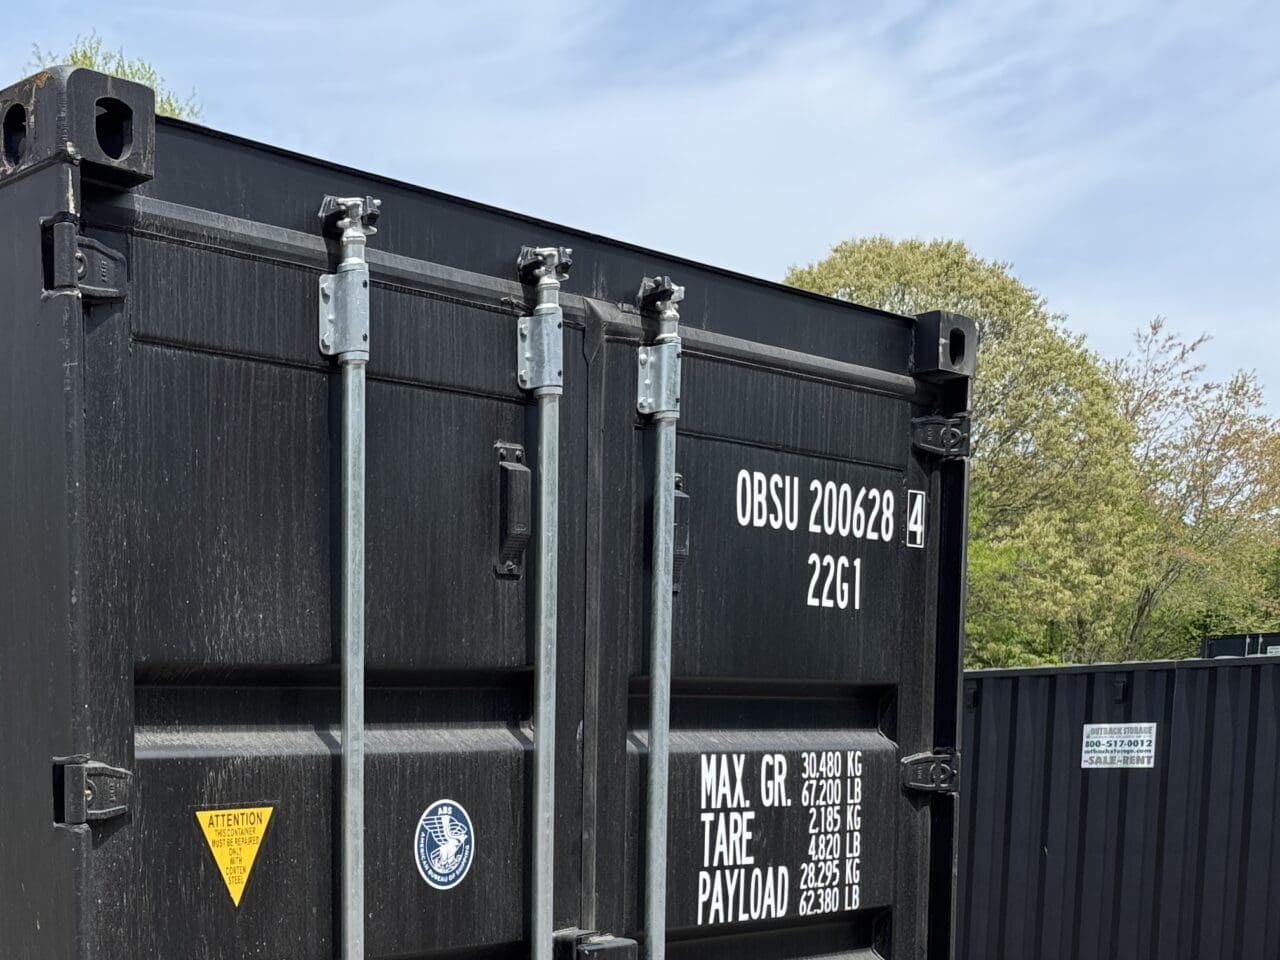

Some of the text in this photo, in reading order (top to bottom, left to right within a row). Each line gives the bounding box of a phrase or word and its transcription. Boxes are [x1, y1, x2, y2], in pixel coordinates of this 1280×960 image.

[736, 469, 923, 544] OBSU 200628 4
[807, 552, 861, 610] 22G1
[1085, 740, 1153, 748] 800-517-0012
[1088, 756, 1117, 765] SALE
[1122, 756, 1153, 765] RENT
[700, 754, 750, 809] MAX.
[760, 754, 792, 808] GR.
[847, 750, 862, 777] KG
[847, 778, 862, 804] LB
[208, 812, 263, 828] ATTENTION
[438, 806, 452, 815] ABS
[700, 811, 755, 868] TARE
[846, 805, 861, 831] KG
[846, 832, 860, 858] LB
[697, 866, 789, 926] PAYLOAD
[845, 858, 860, 885] KG
[844, 885, 860, 911] LB
